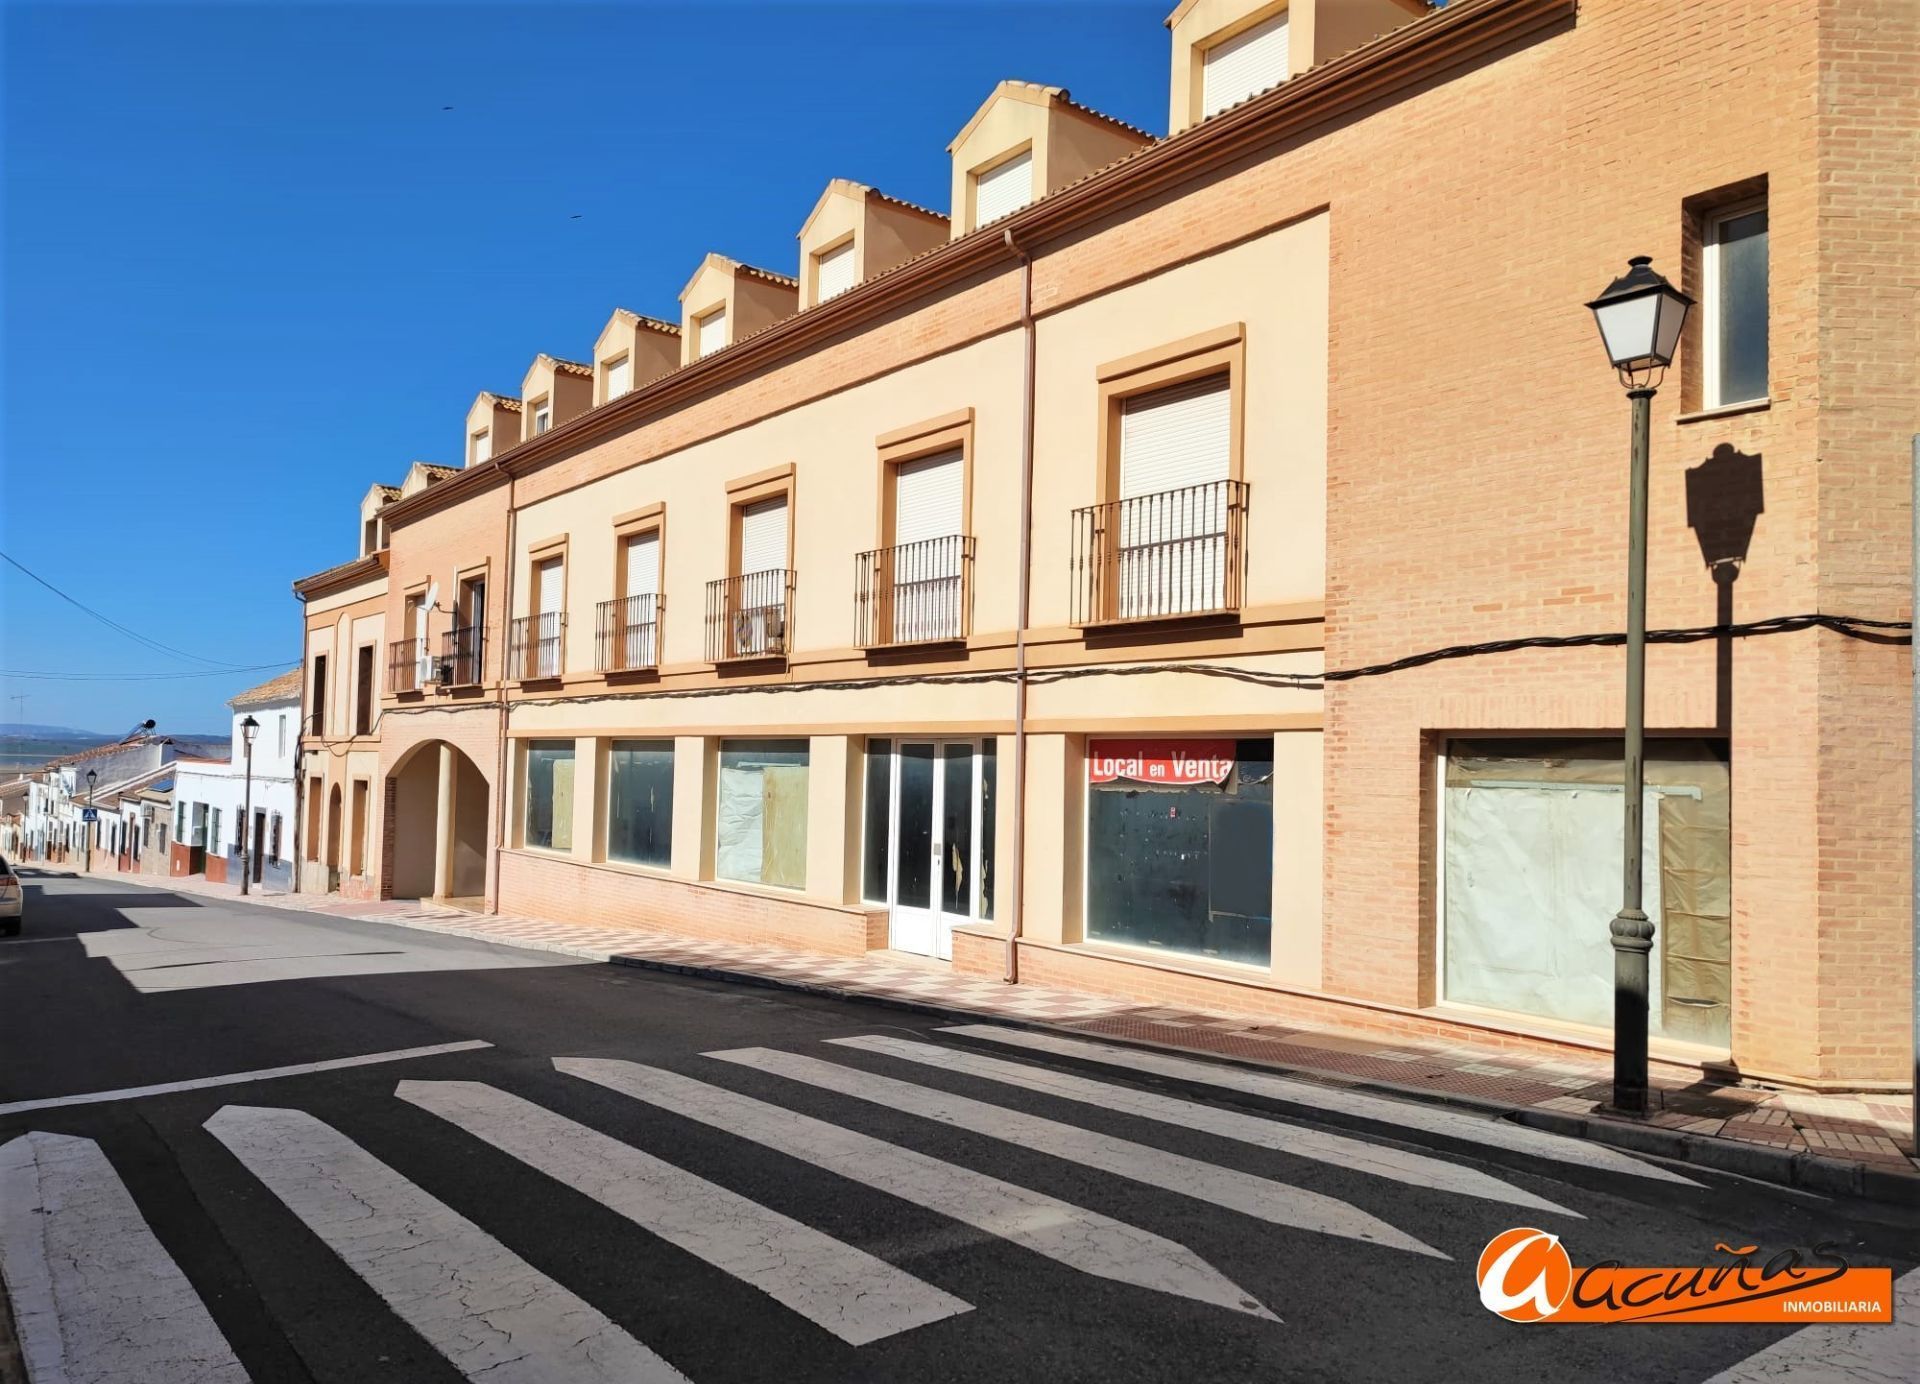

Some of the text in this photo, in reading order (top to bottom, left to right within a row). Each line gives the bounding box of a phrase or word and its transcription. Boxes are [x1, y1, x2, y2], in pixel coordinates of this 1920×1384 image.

[1093, 751, 1234, 778] Local en Venta
